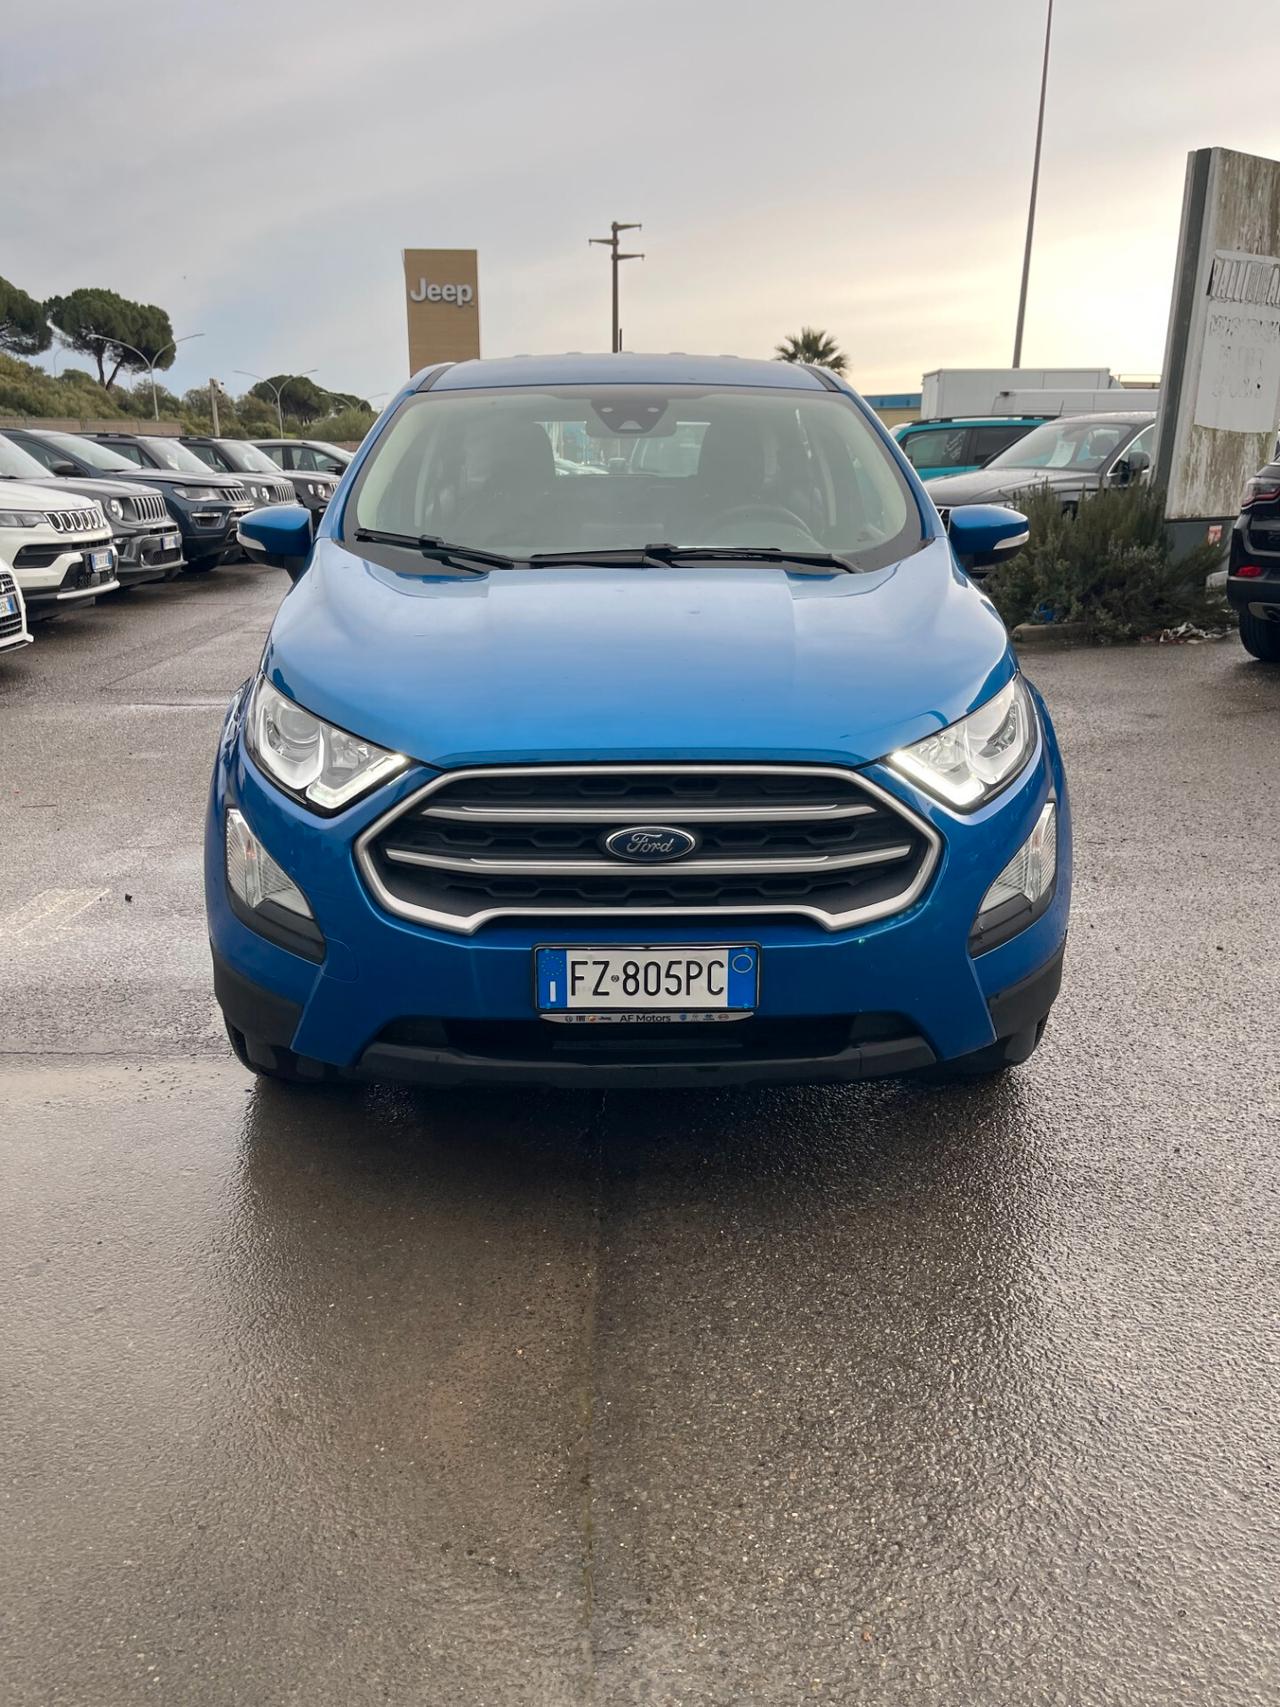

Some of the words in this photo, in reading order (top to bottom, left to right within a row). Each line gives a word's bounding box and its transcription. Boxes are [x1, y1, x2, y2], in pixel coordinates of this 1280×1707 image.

[410, 278, 473, 306] Jeep
[626, 832, 674, 853] Ford
[620, 1015, 634, 1023] AF
[636, 1015, 671, 1023] Motors
